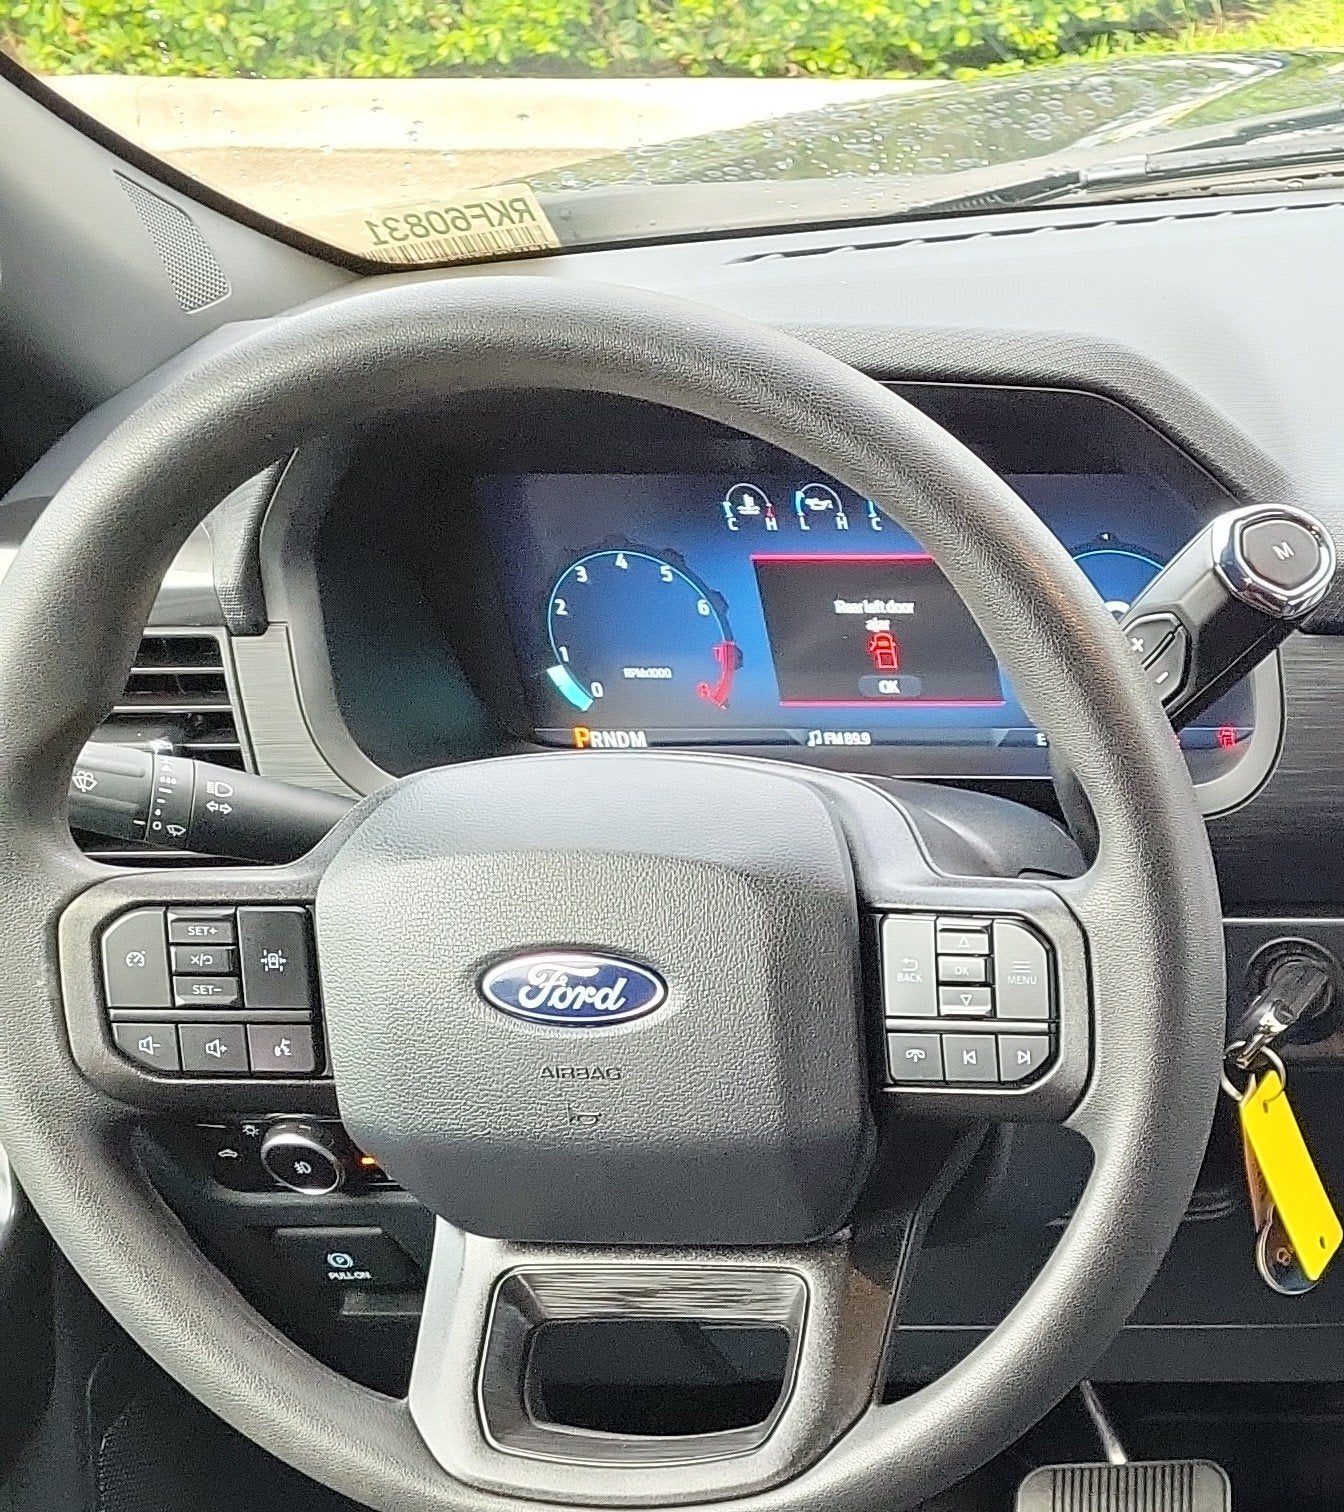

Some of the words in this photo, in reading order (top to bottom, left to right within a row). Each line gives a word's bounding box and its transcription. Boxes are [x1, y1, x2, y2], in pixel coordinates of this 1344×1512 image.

[1272, 541, 1295, 561] M
[615, 552, 628, 569] 4
[574, 566, 588, 582] 3
[660, 566, 673, 582] 5
[555, 599, 568, 615] 2
[697, 599, 710, 616] 6
[558, 646, 570, 662] 1
[590, 682, 604, 698] 0
[878, 679, 900, 694] OK
[897, 972, 923, 983] BACK
[1007, 975, 1037, 986] MENU
[518, 963, 628, 1011] Ford
[540, 1065, 622, 1081] AIRBAG
